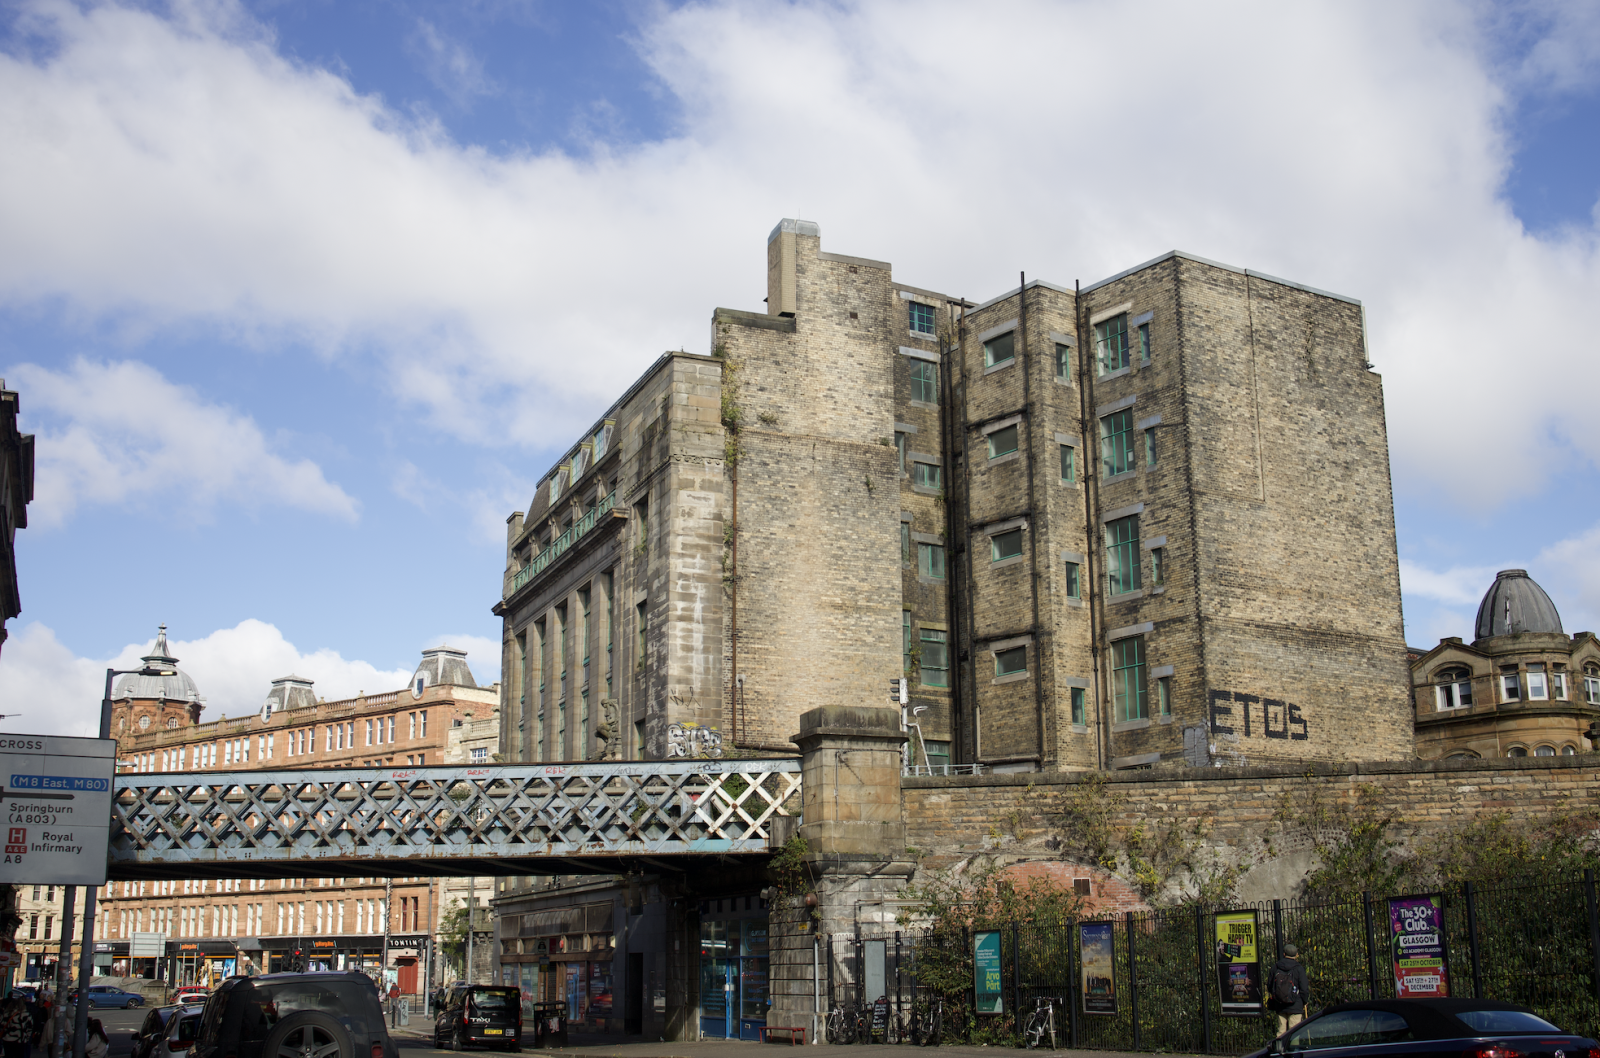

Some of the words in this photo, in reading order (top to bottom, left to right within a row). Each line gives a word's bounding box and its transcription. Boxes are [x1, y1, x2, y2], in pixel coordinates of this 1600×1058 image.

[0, 739, 42, 750] CROSS
[10, 802, 73, 814] Springburn
[11, 829, 23, 842] H
[42, 832, 73, 842] Royal
[31, 843, 82, 854] Infirmary
[1400, 909, 1413, 918] The
[1413, 906, 1433, 919] 30+
[1229, 923, 1252, 933] TRIGGER
[390, 939, 421, 947] TONTIN
[1246, 934, 1254, 944] TV
[1402, 936, 1435, 945] GLASGOW
[986, 971, 1000, 980] Arvo
